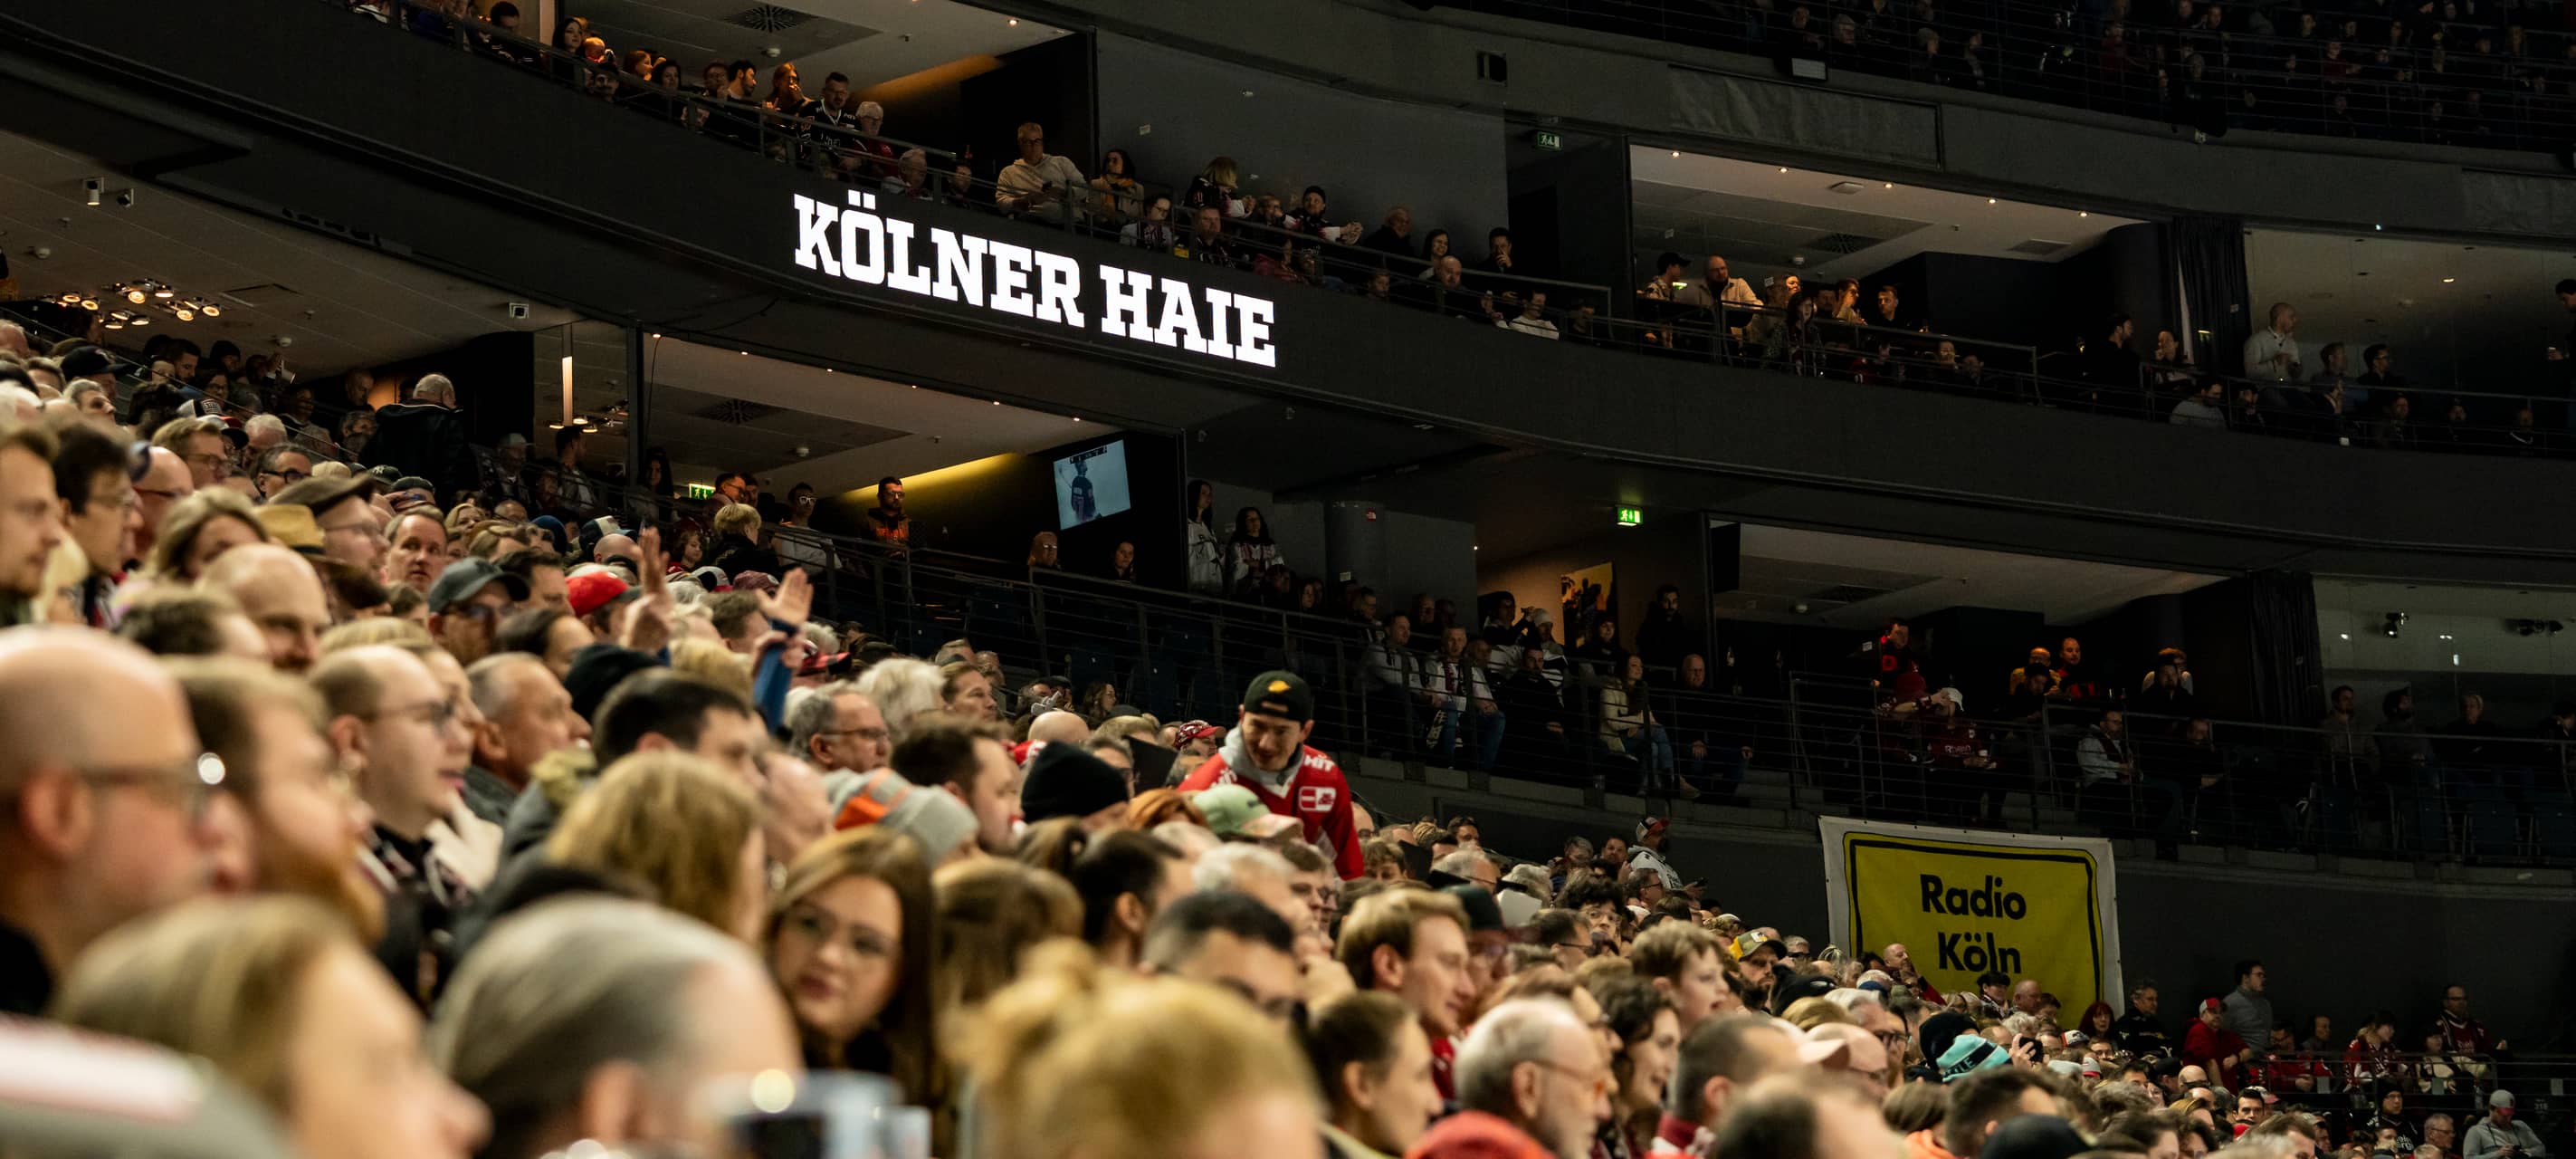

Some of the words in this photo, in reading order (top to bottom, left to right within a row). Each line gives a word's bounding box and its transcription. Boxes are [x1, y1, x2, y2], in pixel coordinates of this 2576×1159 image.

[794, 189, 1084, 328] KÖLNER
[1100, 264, 1276, 367] HAIE
[1920, 874, 2027, 920] Radio
[1938, 932, 2021, 973] Köln
